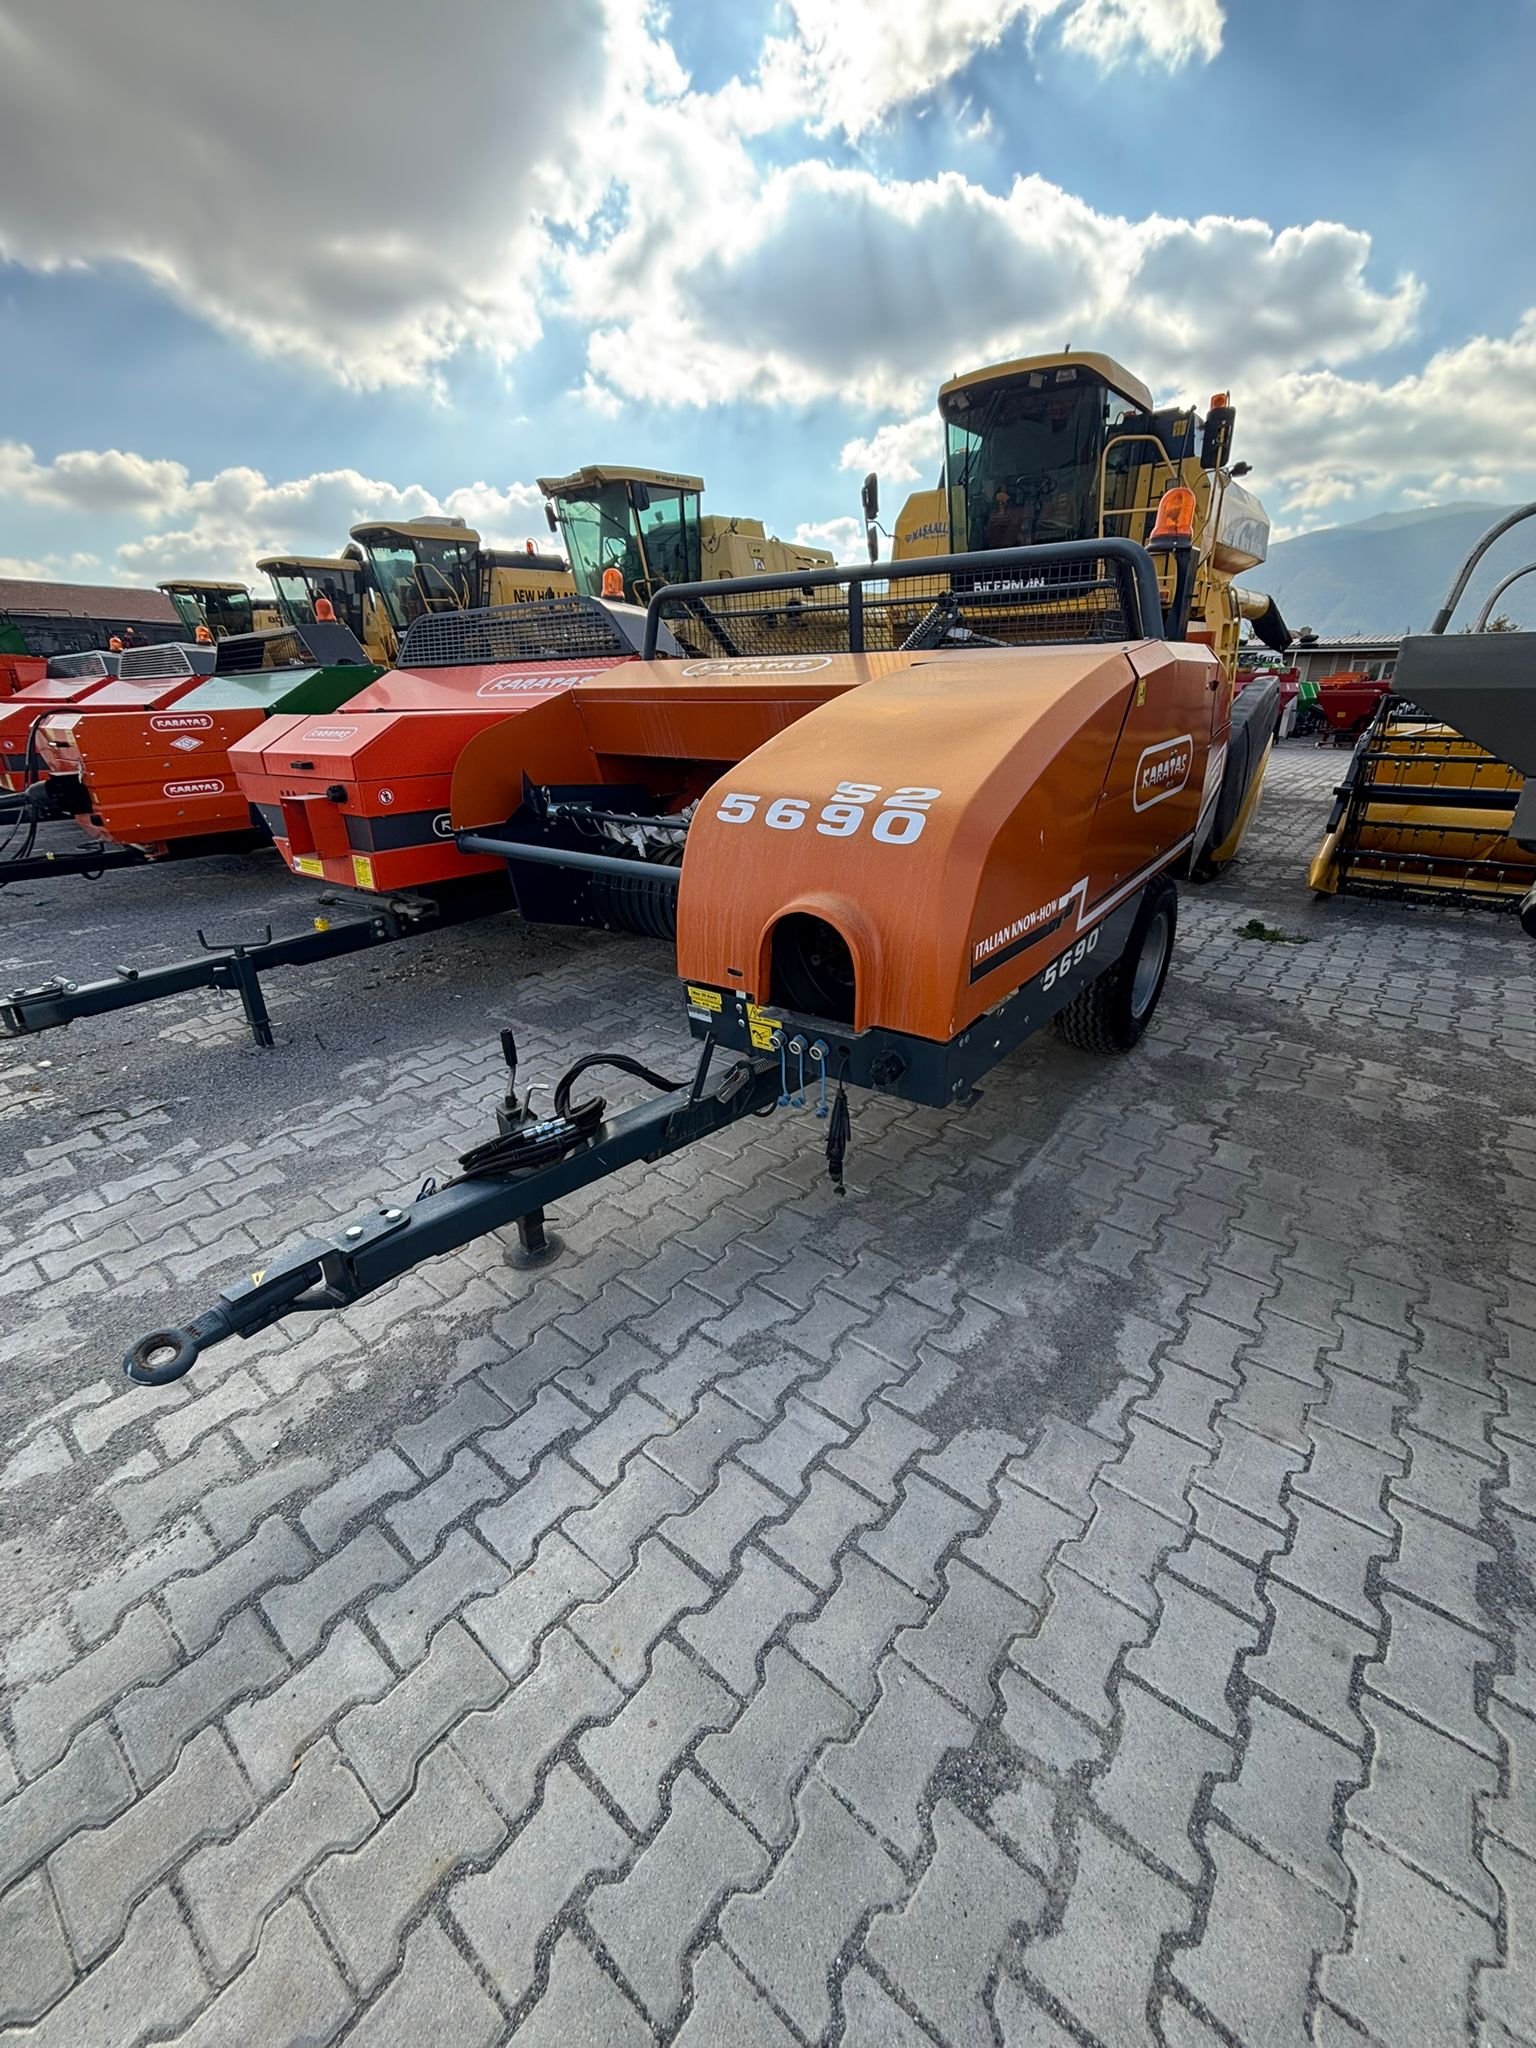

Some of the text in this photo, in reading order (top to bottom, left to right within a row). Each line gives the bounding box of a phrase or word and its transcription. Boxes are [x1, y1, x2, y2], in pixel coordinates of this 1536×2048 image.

[513, 589, 535, 603] NEW
[716, 793, 926, 845] 5690
[831, 781, 942, 809] S2
[975, 899, 1060, 961] ITALIAN KNOW-HOW
[1042, 928, 1100, 992] 5690
